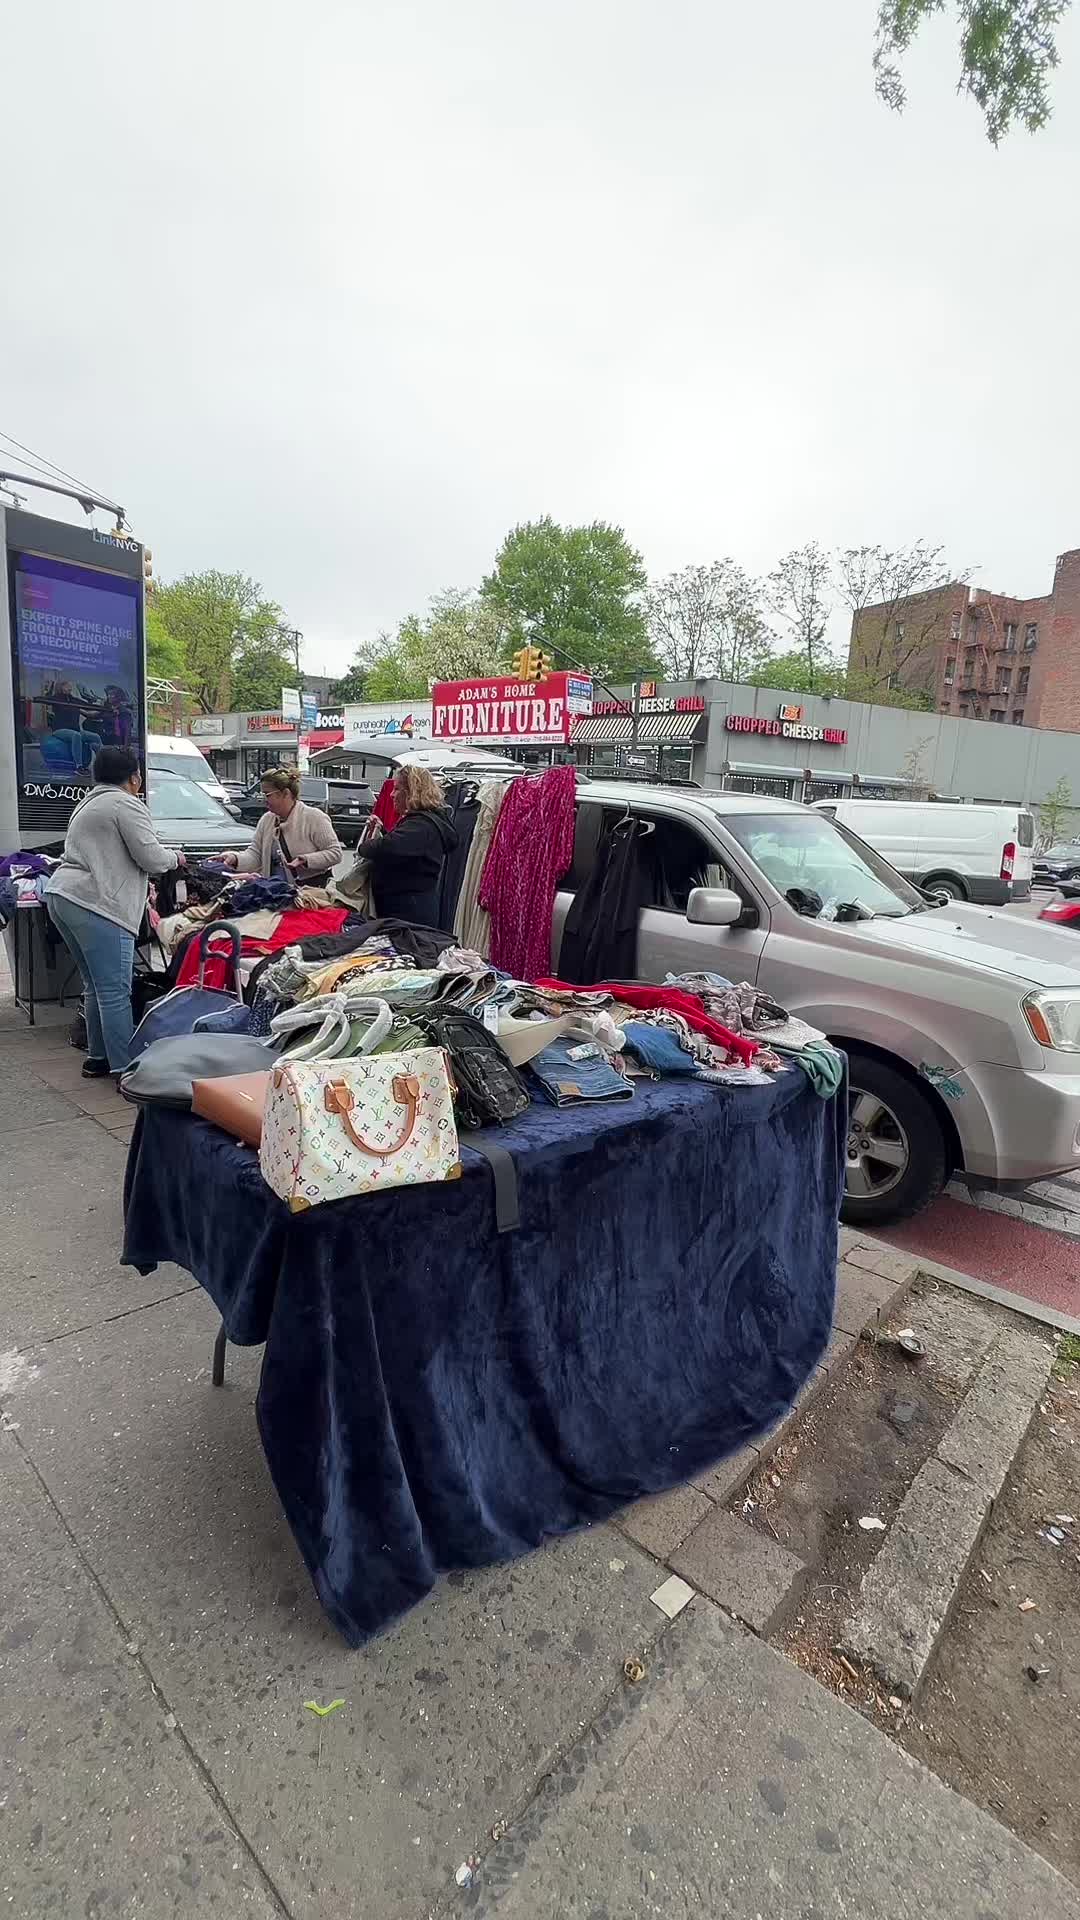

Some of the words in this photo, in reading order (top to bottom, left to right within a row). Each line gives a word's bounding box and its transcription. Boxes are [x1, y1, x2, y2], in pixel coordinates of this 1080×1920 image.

[92, 530, 139, 552] LinkNYC
[21, 608, 67, 627] EXPERT
[69, 617, 102, 634] SPINE
[22, 621, 56, 636] FROM
[58, 627, 120, 647] DIAGNOSIS
[22, 631, 39, 644] TO
[458, 686, 498, 701] ADAM'S
[504, 683, 536, 698] HOME
[434, 697, 564, 735] FURNITURE
[593, 700, 631, 716] OPPED
[675, 695, 705, 712] GRILL
[726, 715, 780, 735] CHOPPED
[782, 722, 819, 740] CHEESE
[824, 728, 848, 744] GRILL
